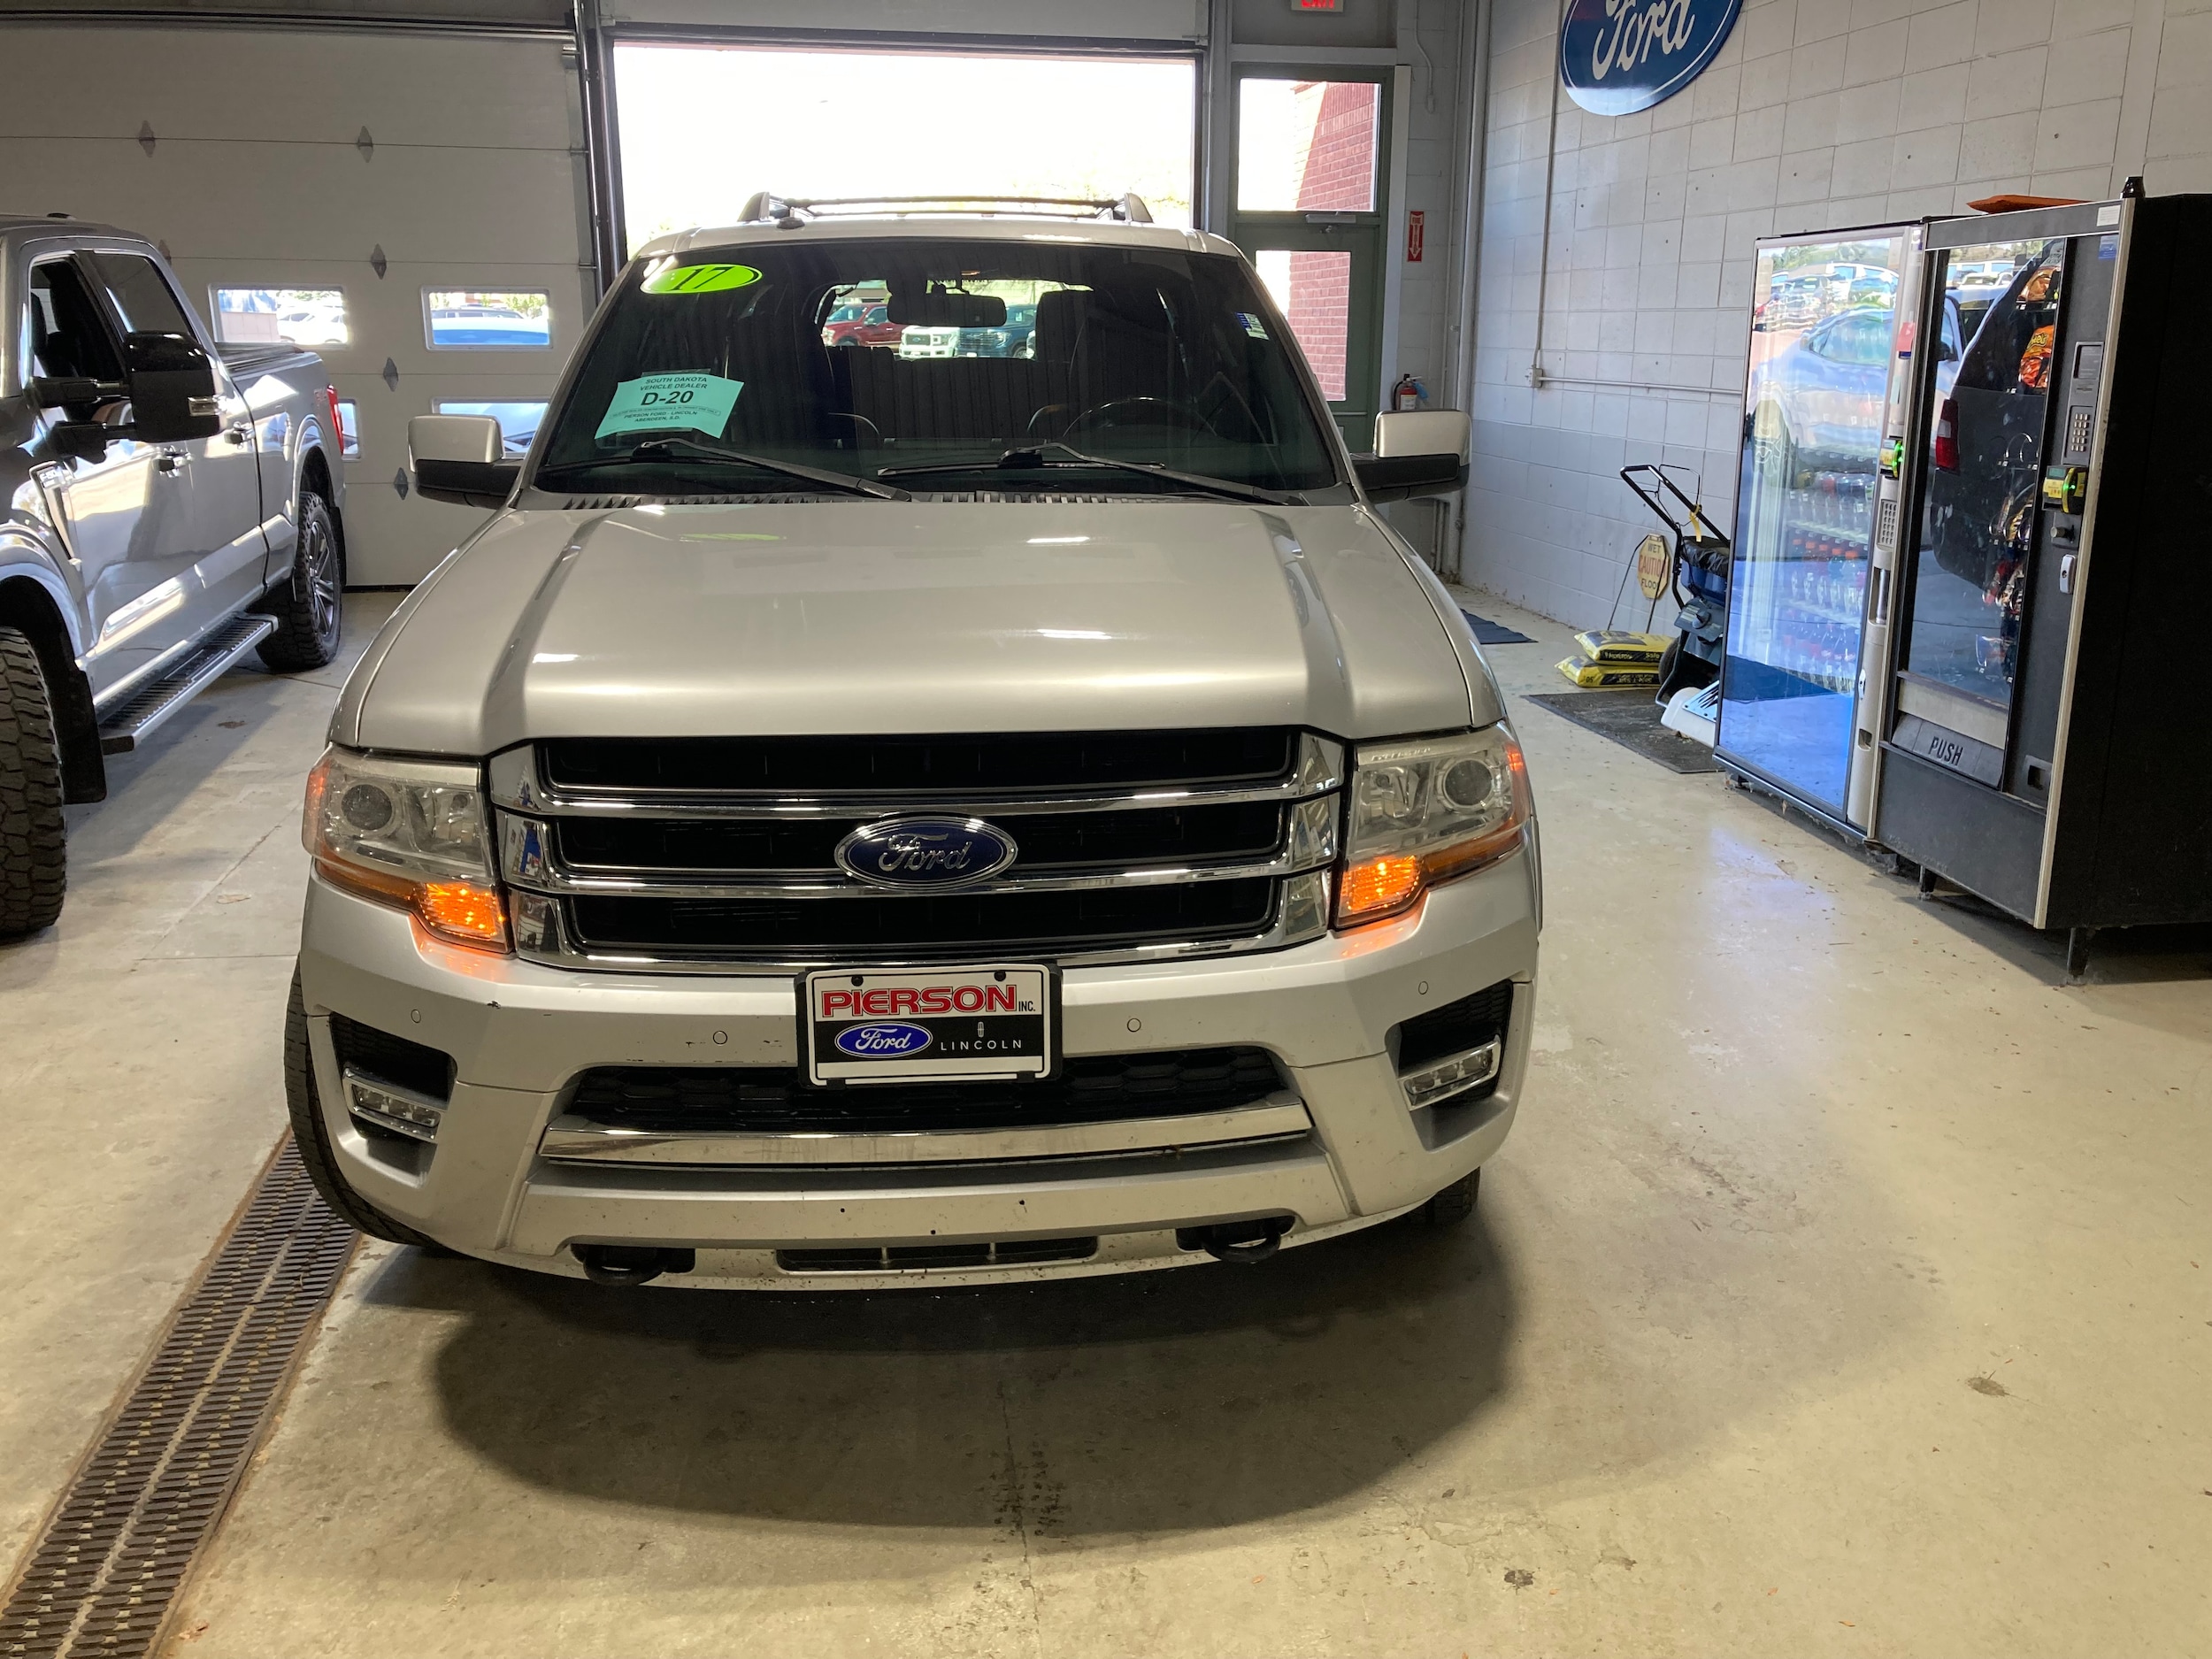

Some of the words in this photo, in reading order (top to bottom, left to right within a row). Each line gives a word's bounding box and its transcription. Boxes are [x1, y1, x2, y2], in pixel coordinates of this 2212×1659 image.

[667, 266, 734, 291] 17
[641, 390, 694, 406] D-20
[1647, 543, 1662, 554] WET
[1641, 578, 1659, 590] FLOO
[1928, 736, 1963, 766] PUSH
[879, 833, 972, 872] Ford
[821, 984, 1017, 1018] PIERSON
[1018, 999, 1035, 1012] INC.
[855, 1025, 911, 1051] Ford
[940, 1039, 1022, 1051] LINCOLN
